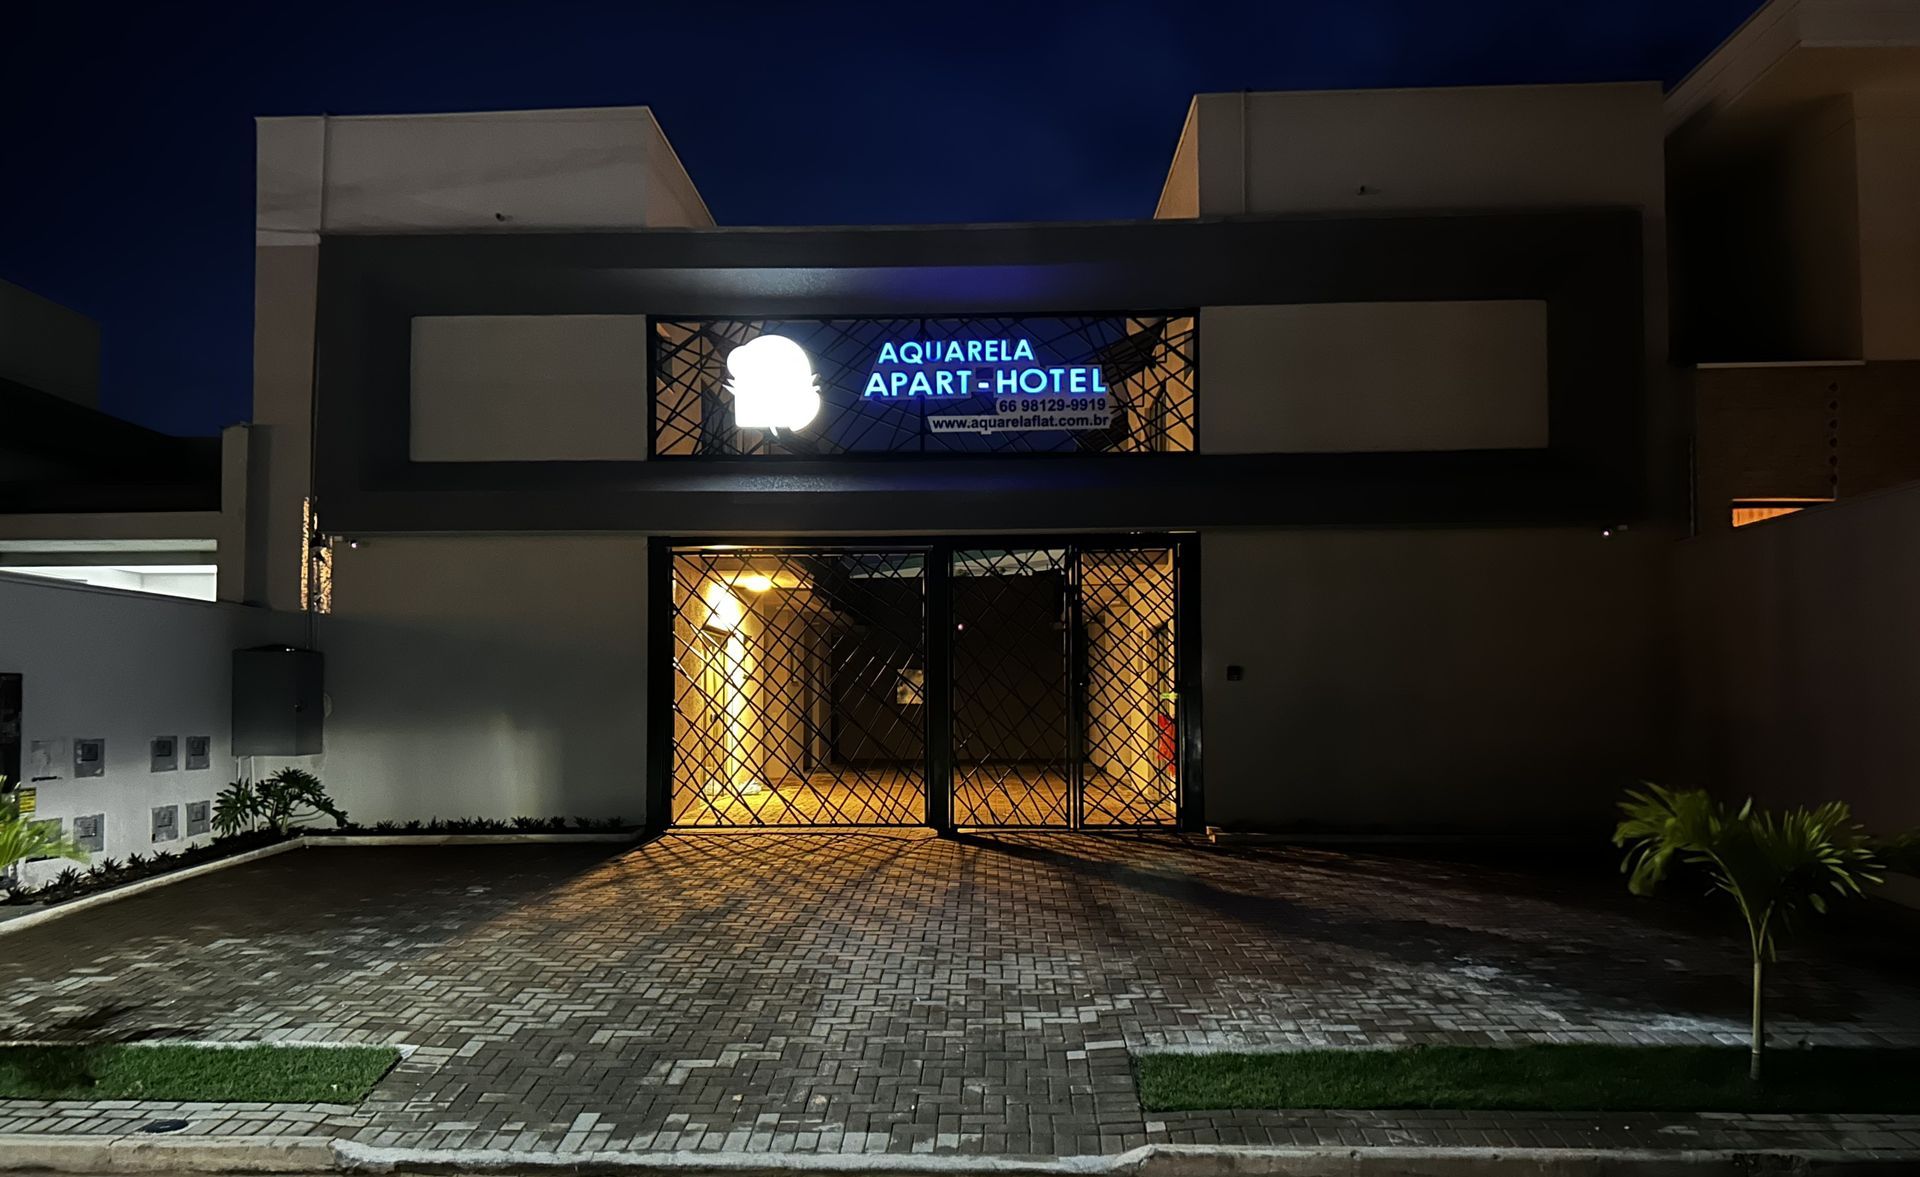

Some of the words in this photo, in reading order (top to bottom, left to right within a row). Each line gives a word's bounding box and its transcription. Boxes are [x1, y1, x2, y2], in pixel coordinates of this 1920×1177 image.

[878, 339, 1034, 364] AQUARELA
[999, 400, 1017, 413] 66
[1022, 398, 1106, 412] 98129-9919
[932, 414, 1109, 431] www.aquarelaflat.com.br
